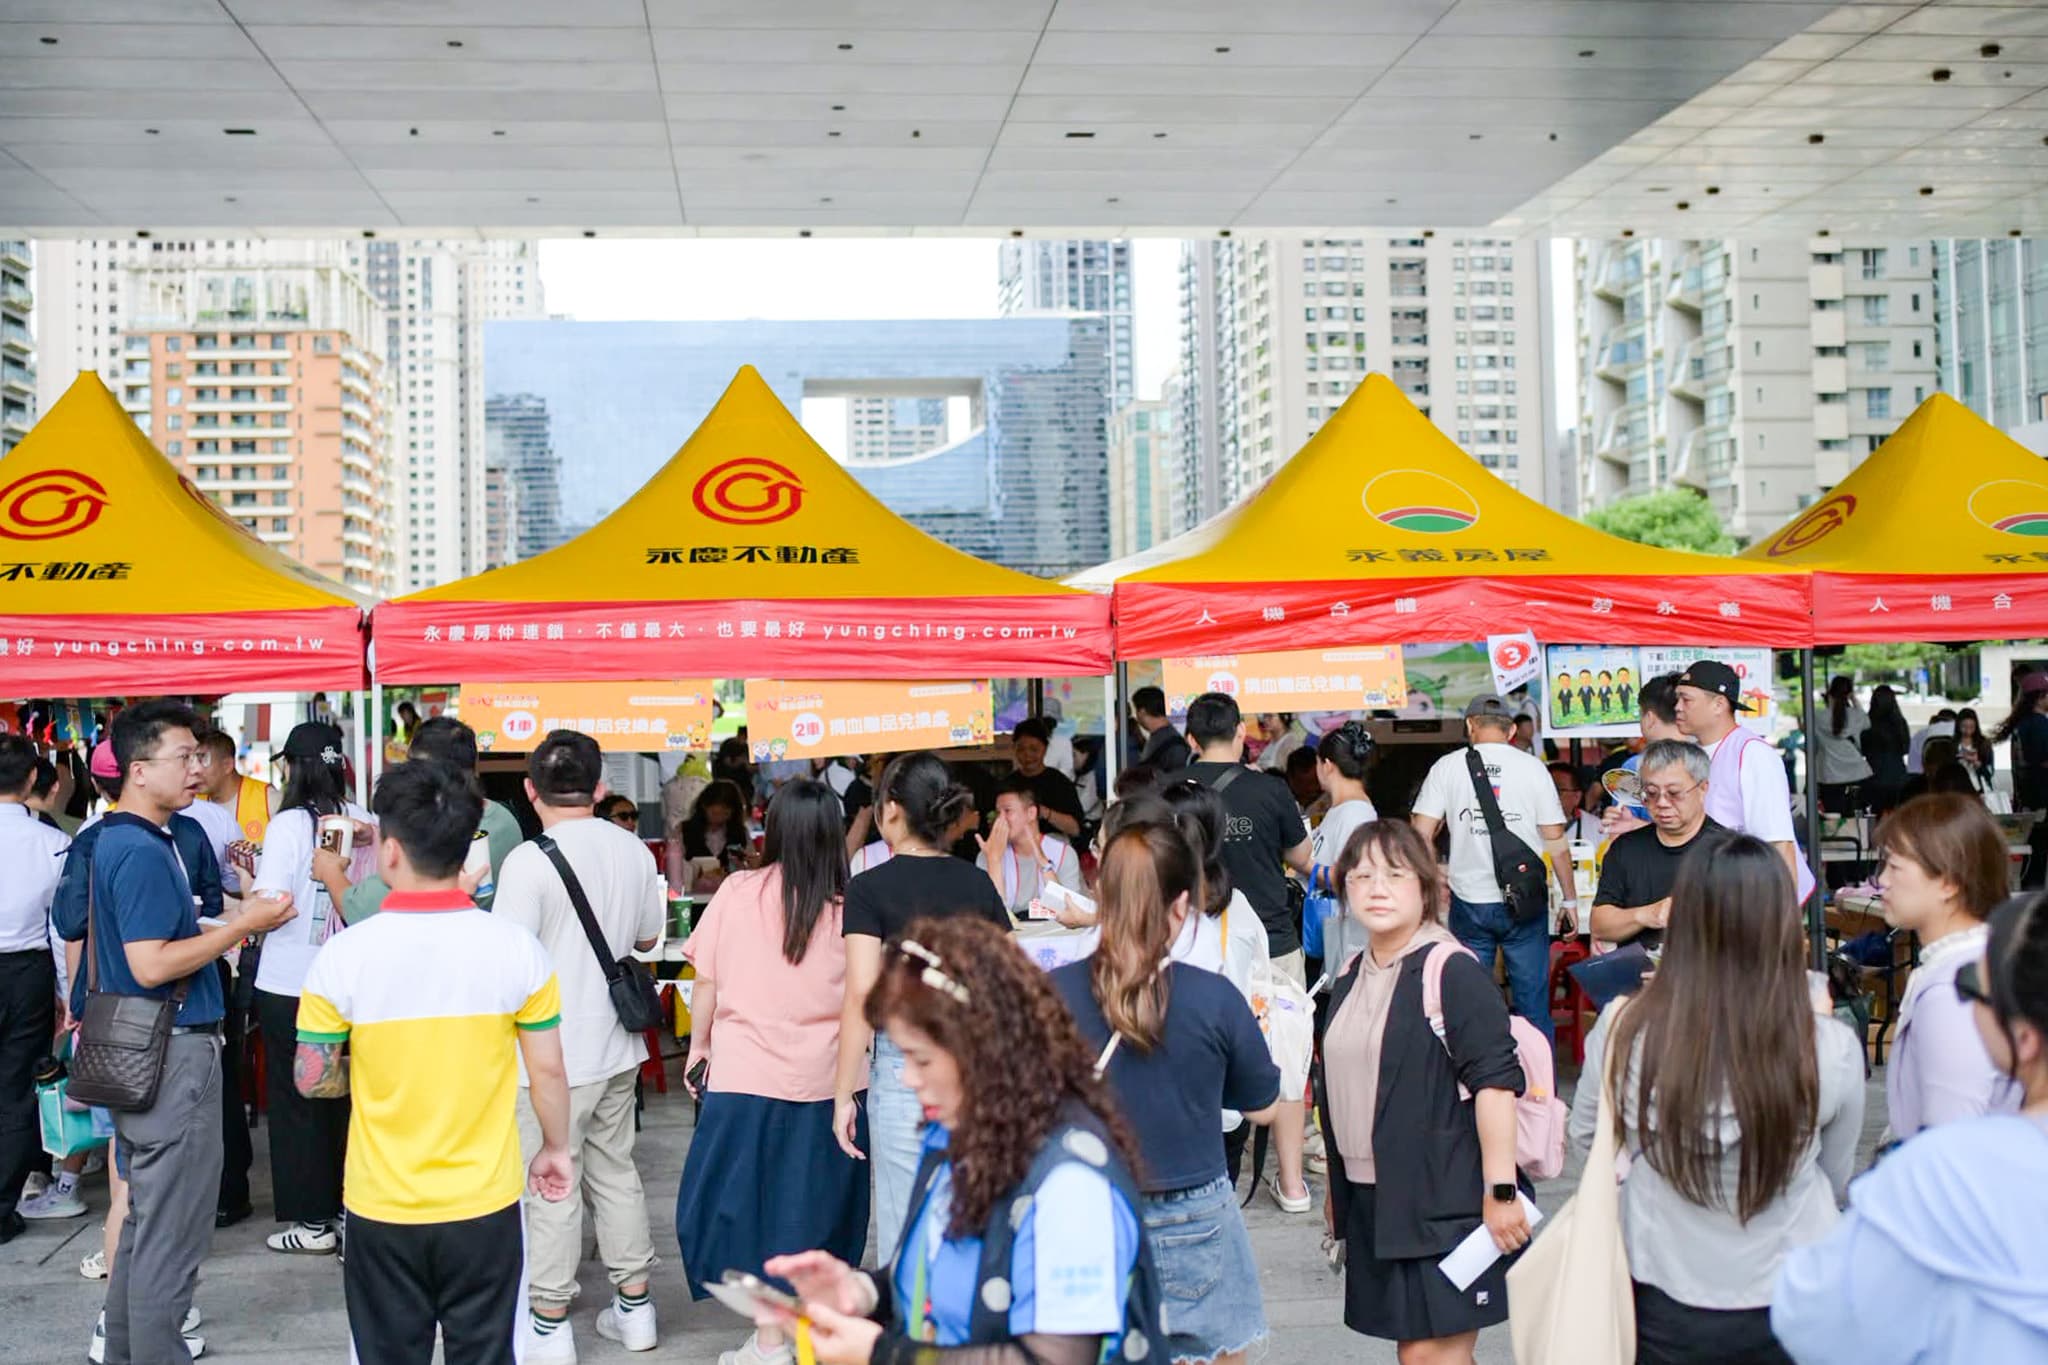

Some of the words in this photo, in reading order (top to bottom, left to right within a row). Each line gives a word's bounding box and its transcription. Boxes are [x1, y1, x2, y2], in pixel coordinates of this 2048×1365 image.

[646, 546, 860, 564] 永慶不動產
[1346, 548, 1553, 563] 永義房屋
[822, 623, 1077, 640] yungching.com.tw
[53, 635, 324, 657] yungching.com.tw
[1503, 647, 1522, 666] 3
